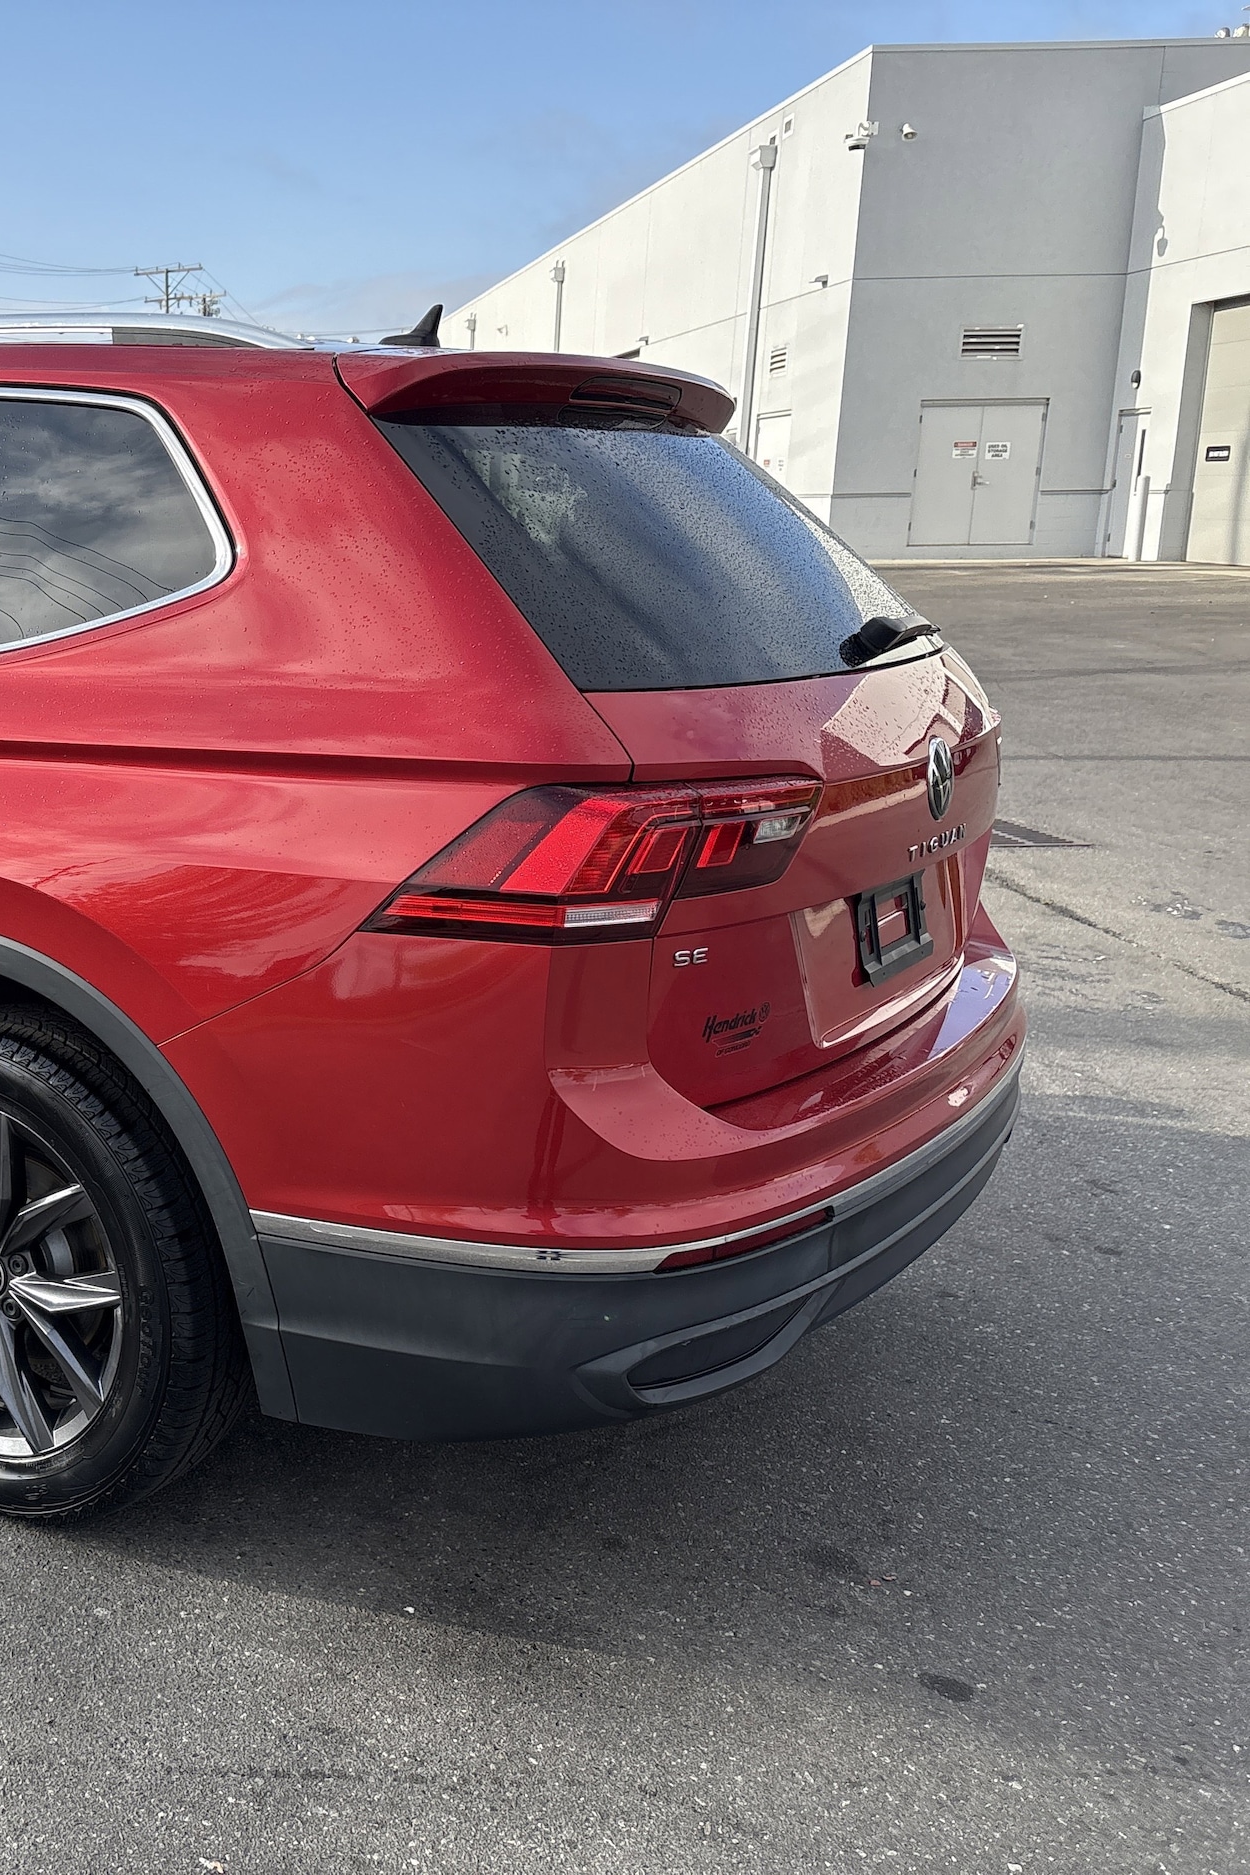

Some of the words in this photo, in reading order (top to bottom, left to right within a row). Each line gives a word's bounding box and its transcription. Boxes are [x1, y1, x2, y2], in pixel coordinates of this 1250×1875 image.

[907, 823, 967, 862] TIGUAN
[673, 947, 709, 967] SE
[701, 1008, 757, 1044] Hendrick
